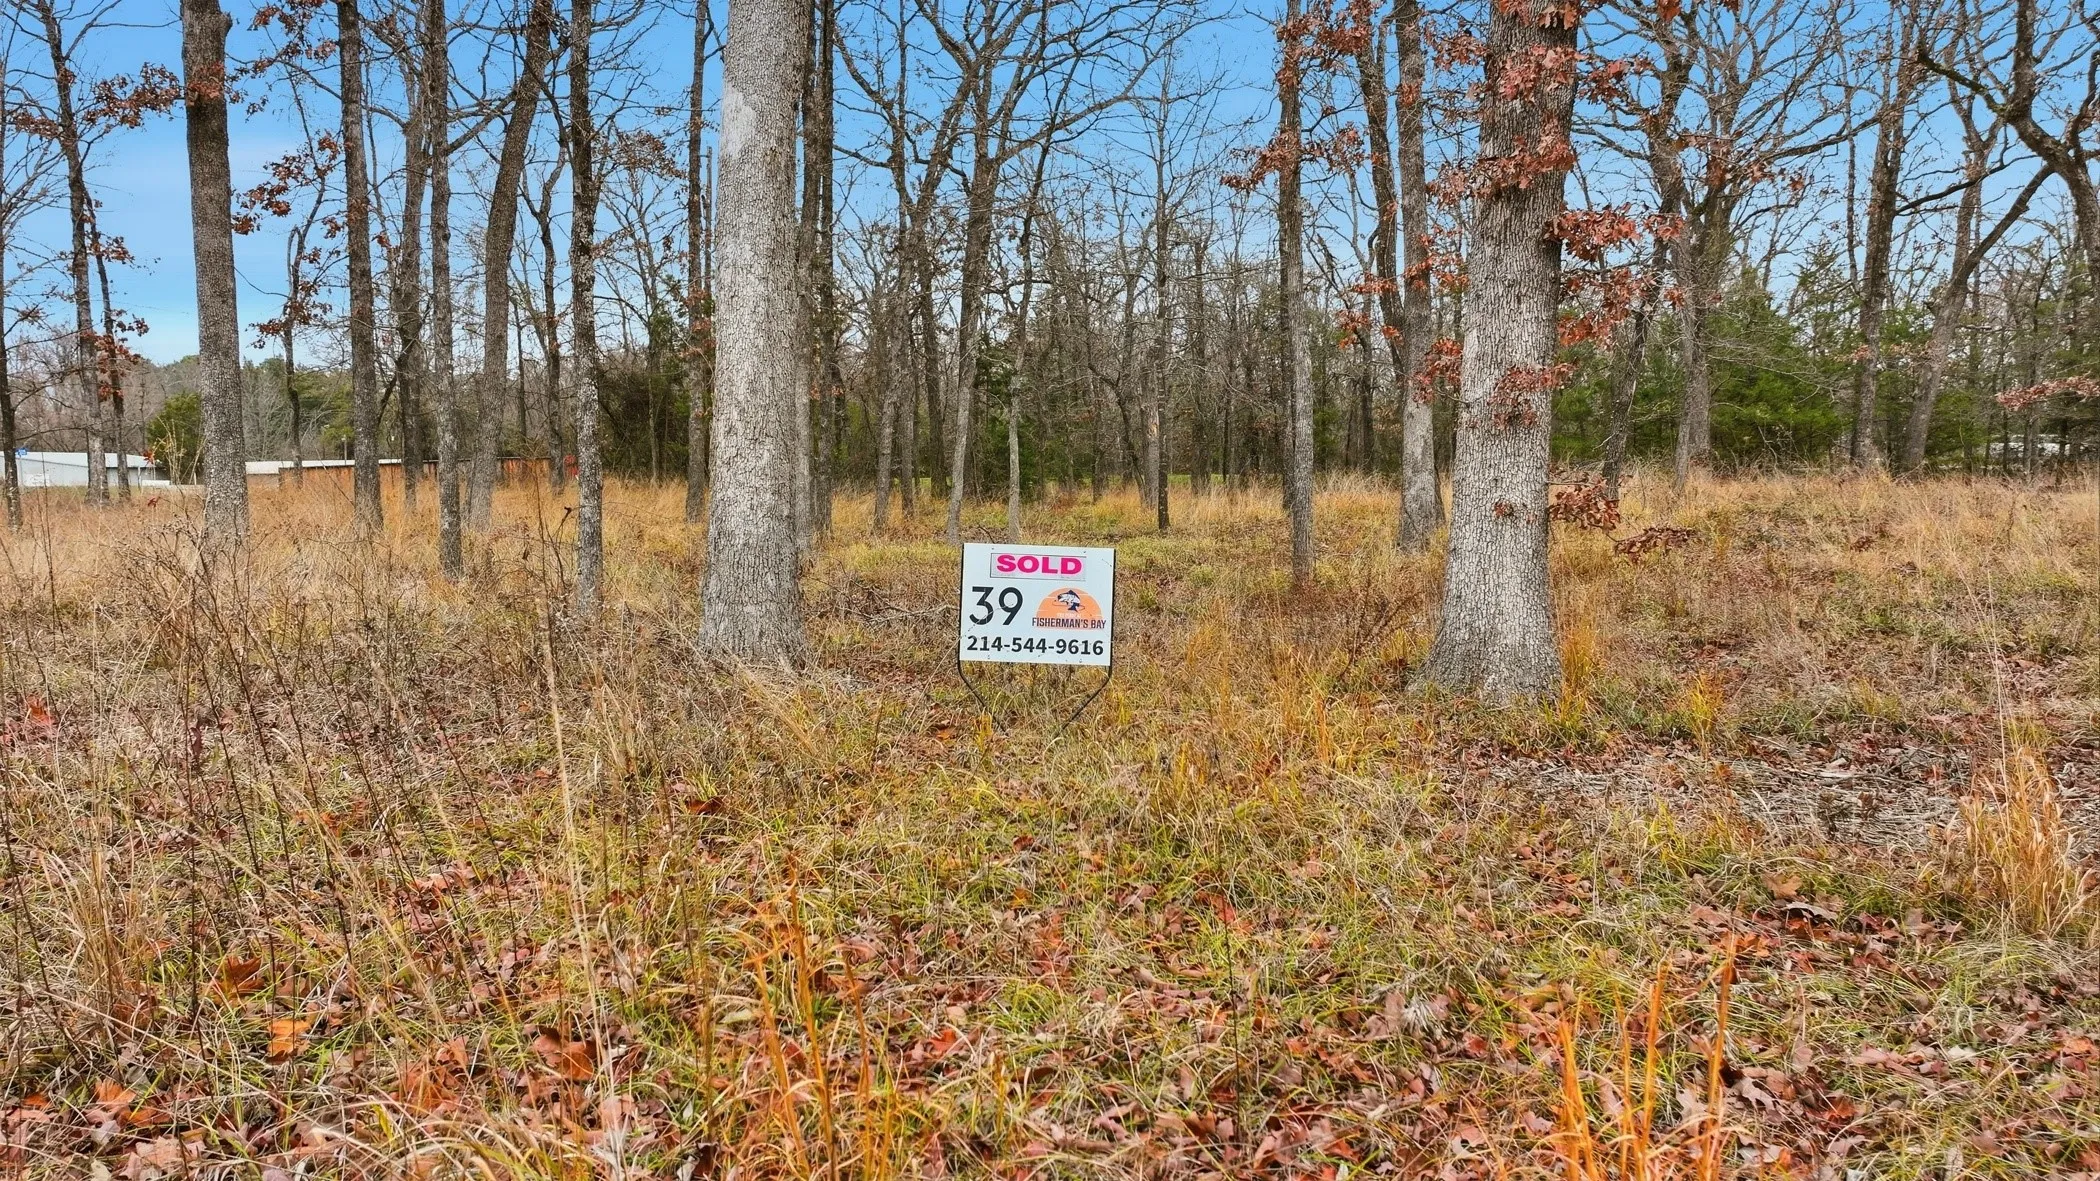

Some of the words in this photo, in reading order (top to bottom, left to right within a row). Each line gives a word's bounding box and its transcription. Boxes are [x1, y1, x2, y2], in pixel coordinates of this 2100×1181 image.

[997, 554, 1082, 575] SOLD
[969, 586, 1024, 626] 39
[1032, 617, 1089, 629] FISHERMAN'S
[1091, 619, 1107, 629] BAY
[966, 635, 1104, 656] 214-544-9616
